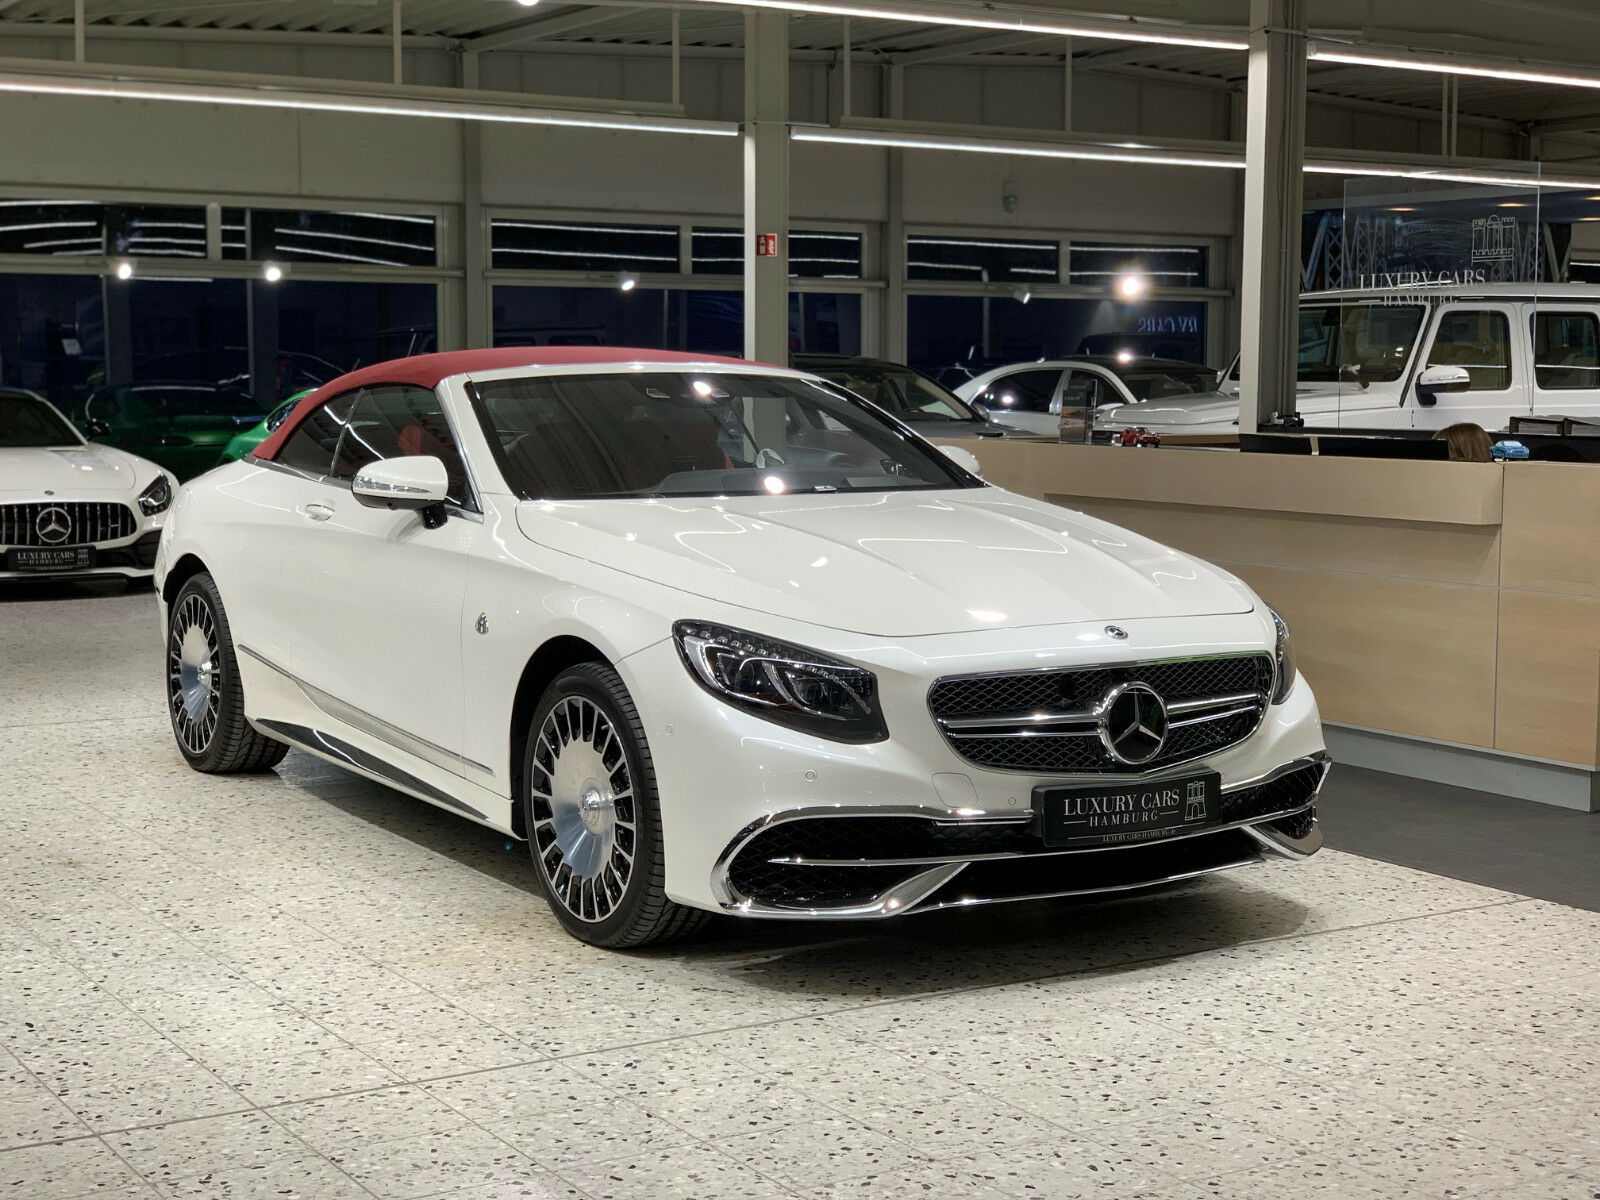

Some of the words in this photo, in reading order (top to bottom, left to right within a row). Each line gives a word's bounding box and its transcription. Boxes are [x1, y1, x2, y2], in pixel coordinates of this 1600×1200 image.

[1359, 271, 1433, 292] LUXURY
[1437, 268, 1486, 289] CARS
[17, 551, 52, 560] LUXURY
[53, 550, 75, 559] CARS
[1063, 794, 1138, 816] LUXURY
[1141, 788, 1180, 809] CARS
[1089, 810, 1159, 827] HAMBURG
